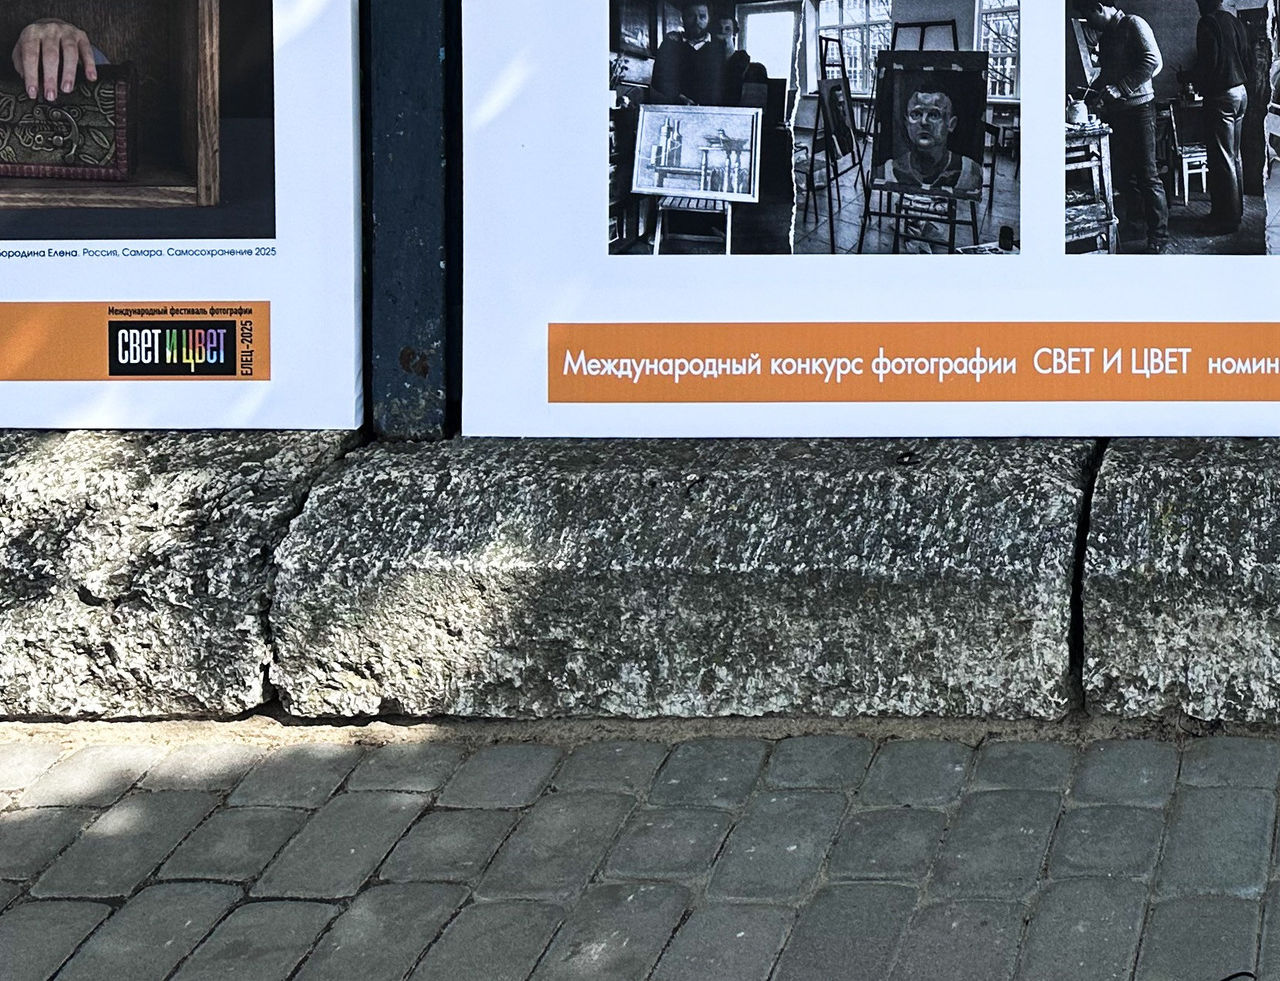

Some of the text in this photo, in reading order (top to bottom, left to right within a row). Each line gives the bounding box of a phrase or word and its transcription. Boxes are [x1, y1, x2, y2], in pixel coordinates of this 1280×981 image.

[82, 247, 120, 258] Россия,
[166, 247, 253, 258] Самосохранение
[255, 246, 277, 257] 2025
[107, 306, 253, 317] Международный фестиваль фотографии
[165, 329, 178, 364] И
[563, 349, 762, 384] Международный
[770, 354, 864, 384] конкурс
[871, 346, 1017, 383] фотографии
[1033, 347, 1095, 375] СВЕТ
[1102, 347, 1122, 374] И
[1131, 347, 1192, 379] ЦВЕТ
